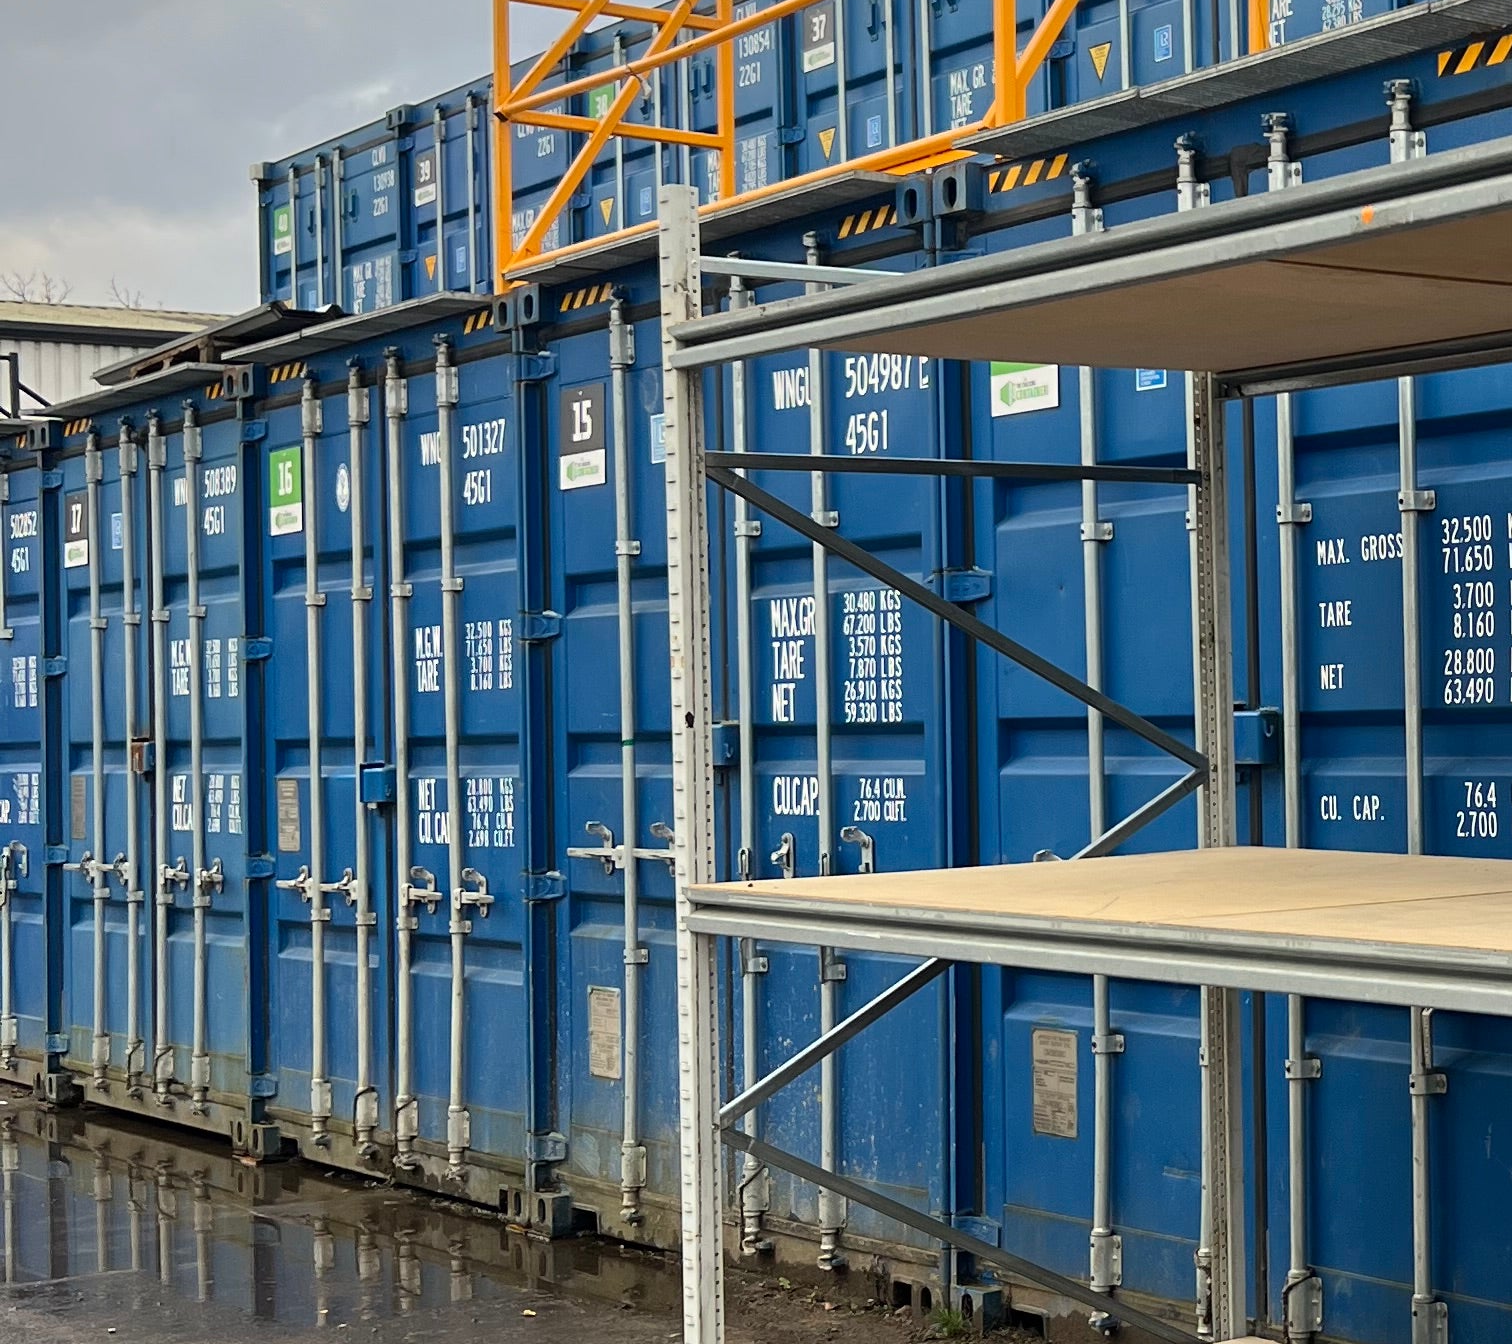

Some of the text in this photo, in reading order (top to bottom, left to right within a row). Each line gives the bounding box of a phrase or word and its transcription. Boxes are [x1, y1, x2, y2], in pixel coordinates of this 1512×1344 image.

[812, 14, 826, 42] 37
[572, 399, 592, 442] 15
[845, 409, 888, 454] 45G1
[463, 418, 505, 459] 501327
[204, 465, 237, 498] 508389
[278, 460, 293, 496] 16
[464, 469, 491, 505] 45G1
[71, 503, 82, 534] 17
[204, 505, 225, 535] 45G1
[1317, 532, 1403, 566] MAX. GROSS
[880, 590, 901, 611] KGS
[1318, 600, 1352, 627] TARE
[880, 612, 902, 634] LBS
[772, 639, 805, 680] TARE
[880, 634, 902, 656] KGS
[416, 659, 440, 692] TARE
[881, 656, 902, 678] LBS
[1320, 663, 1344, 690] NET
[772, 683, 796, 722] NET
[881, 679, 903, 700] KGS
[881, 701, 903, 723] LBS
[418, 778, 436, 810] NET
[859, 778, 880, 798] 76.4
[1464, 782, 1497, 808] 76.4
[1321, 795, 1385, 821] CU. CAP.
